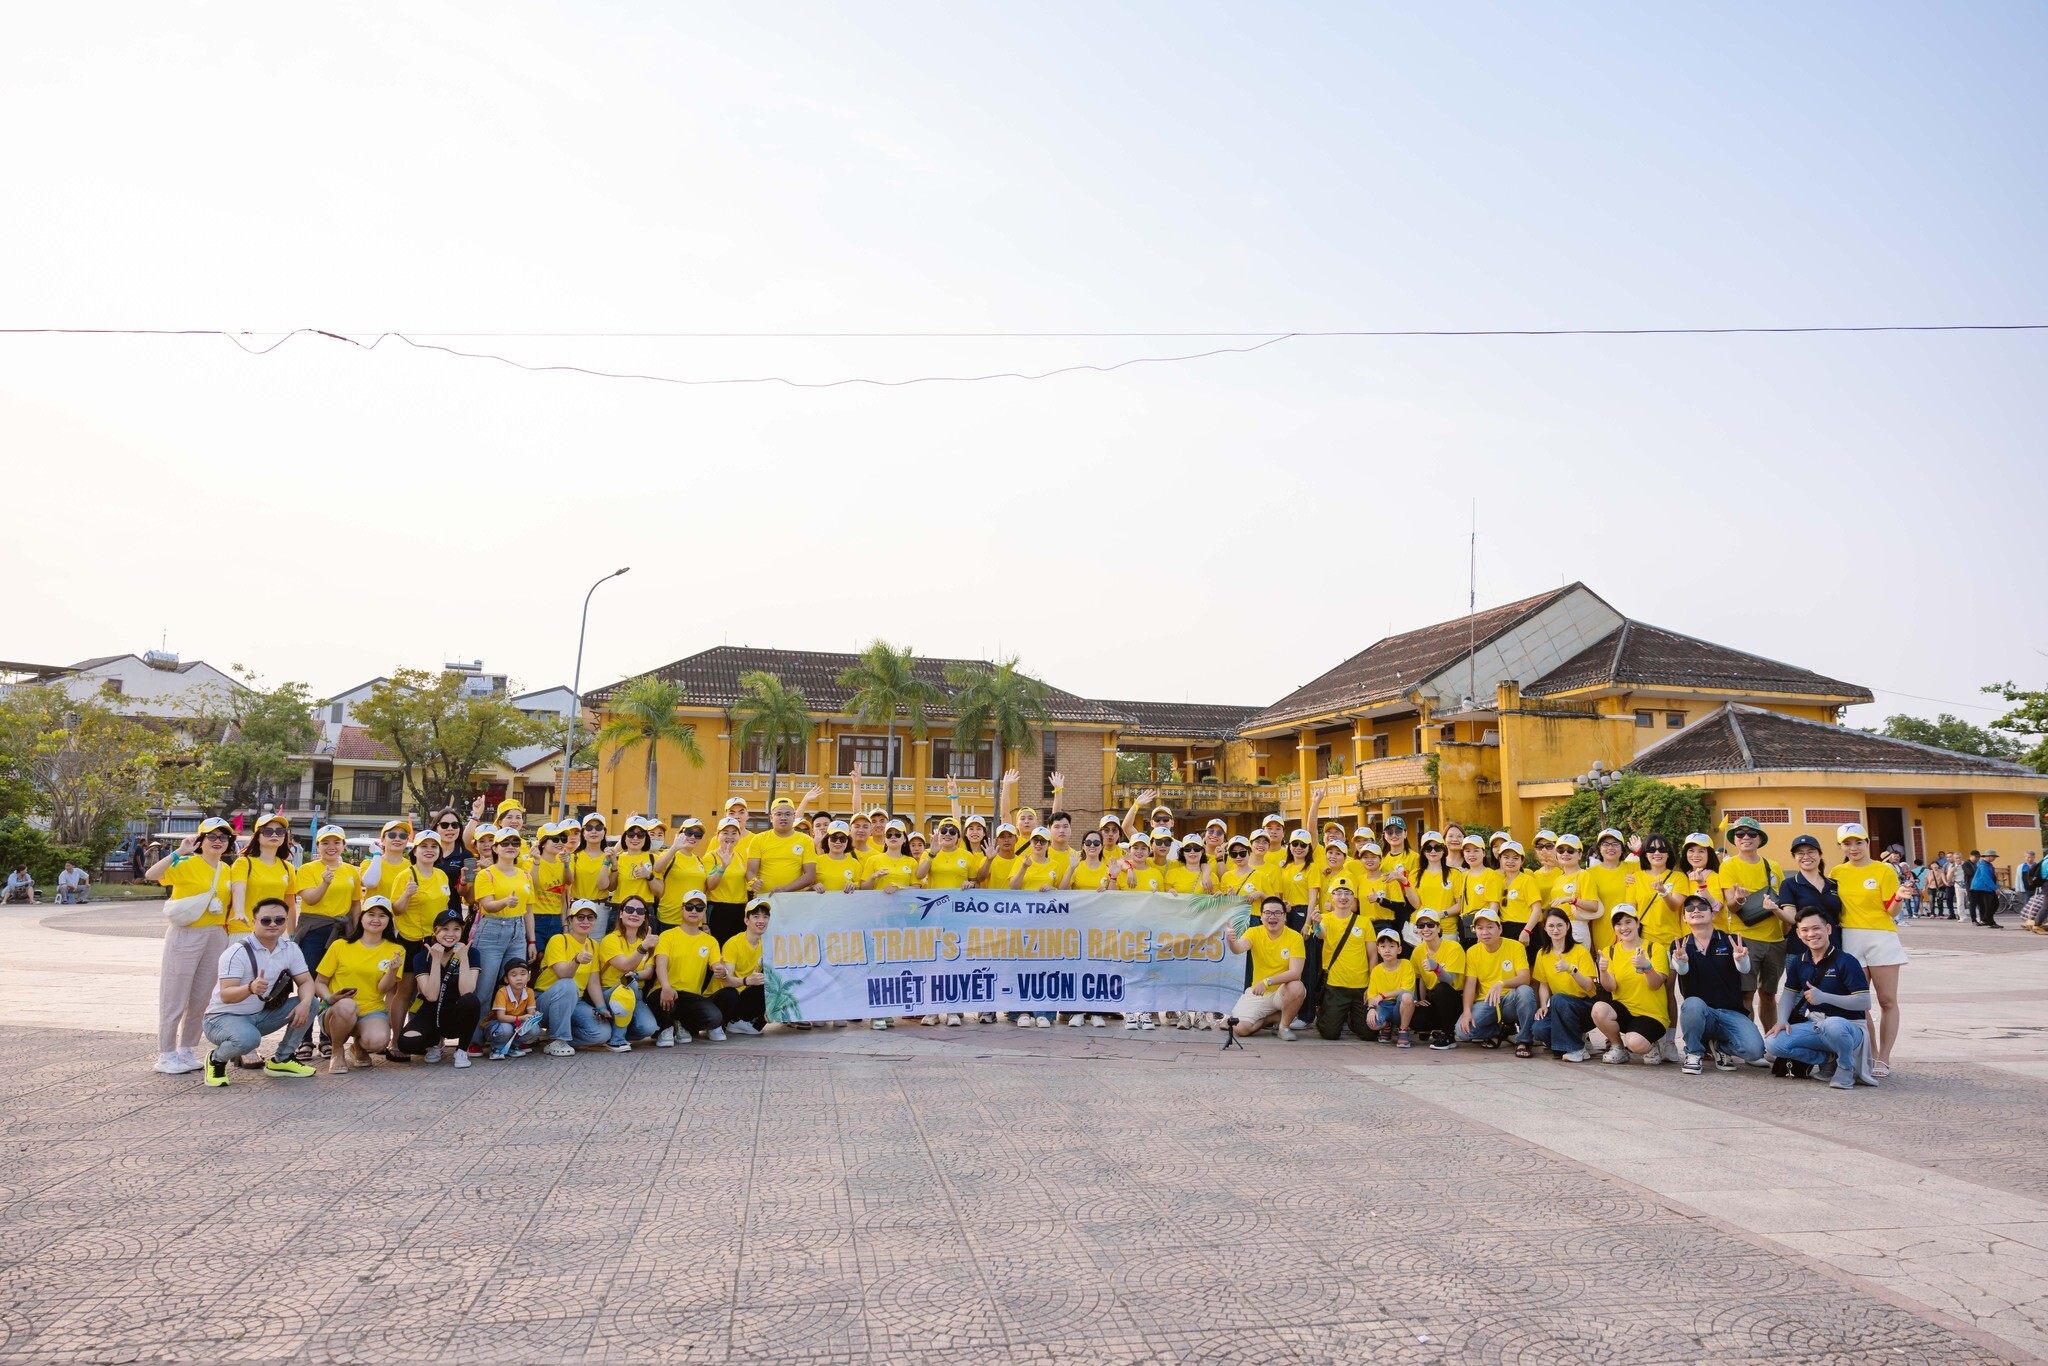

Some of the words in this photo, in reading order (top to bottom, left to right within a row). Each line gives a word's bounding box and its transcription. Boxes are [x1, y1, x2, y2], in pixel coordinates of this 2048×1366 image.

[936, 896, 950, 906] BGT
[954, 897, 989, 913] BẢO
[994, 901, 1022, 913] GIA
[1026, 898, 1070, 914] TRẦN
[773, 932, 822, 969] BAO
[826, 929, 869, 967] GIA
[966, 928, 1081, 961] AMAZING
[1087, 928, 1152, 963] RACE
[1156, 930, 1226, 962] 2025
[867, 969, 926, 1012] NHIỆT
[931, 967, 997, 1003] HUYẾT
[1017, 970, 1077, 1001] VƯƠN
[1081, 972, 1125, 1002] CAO
